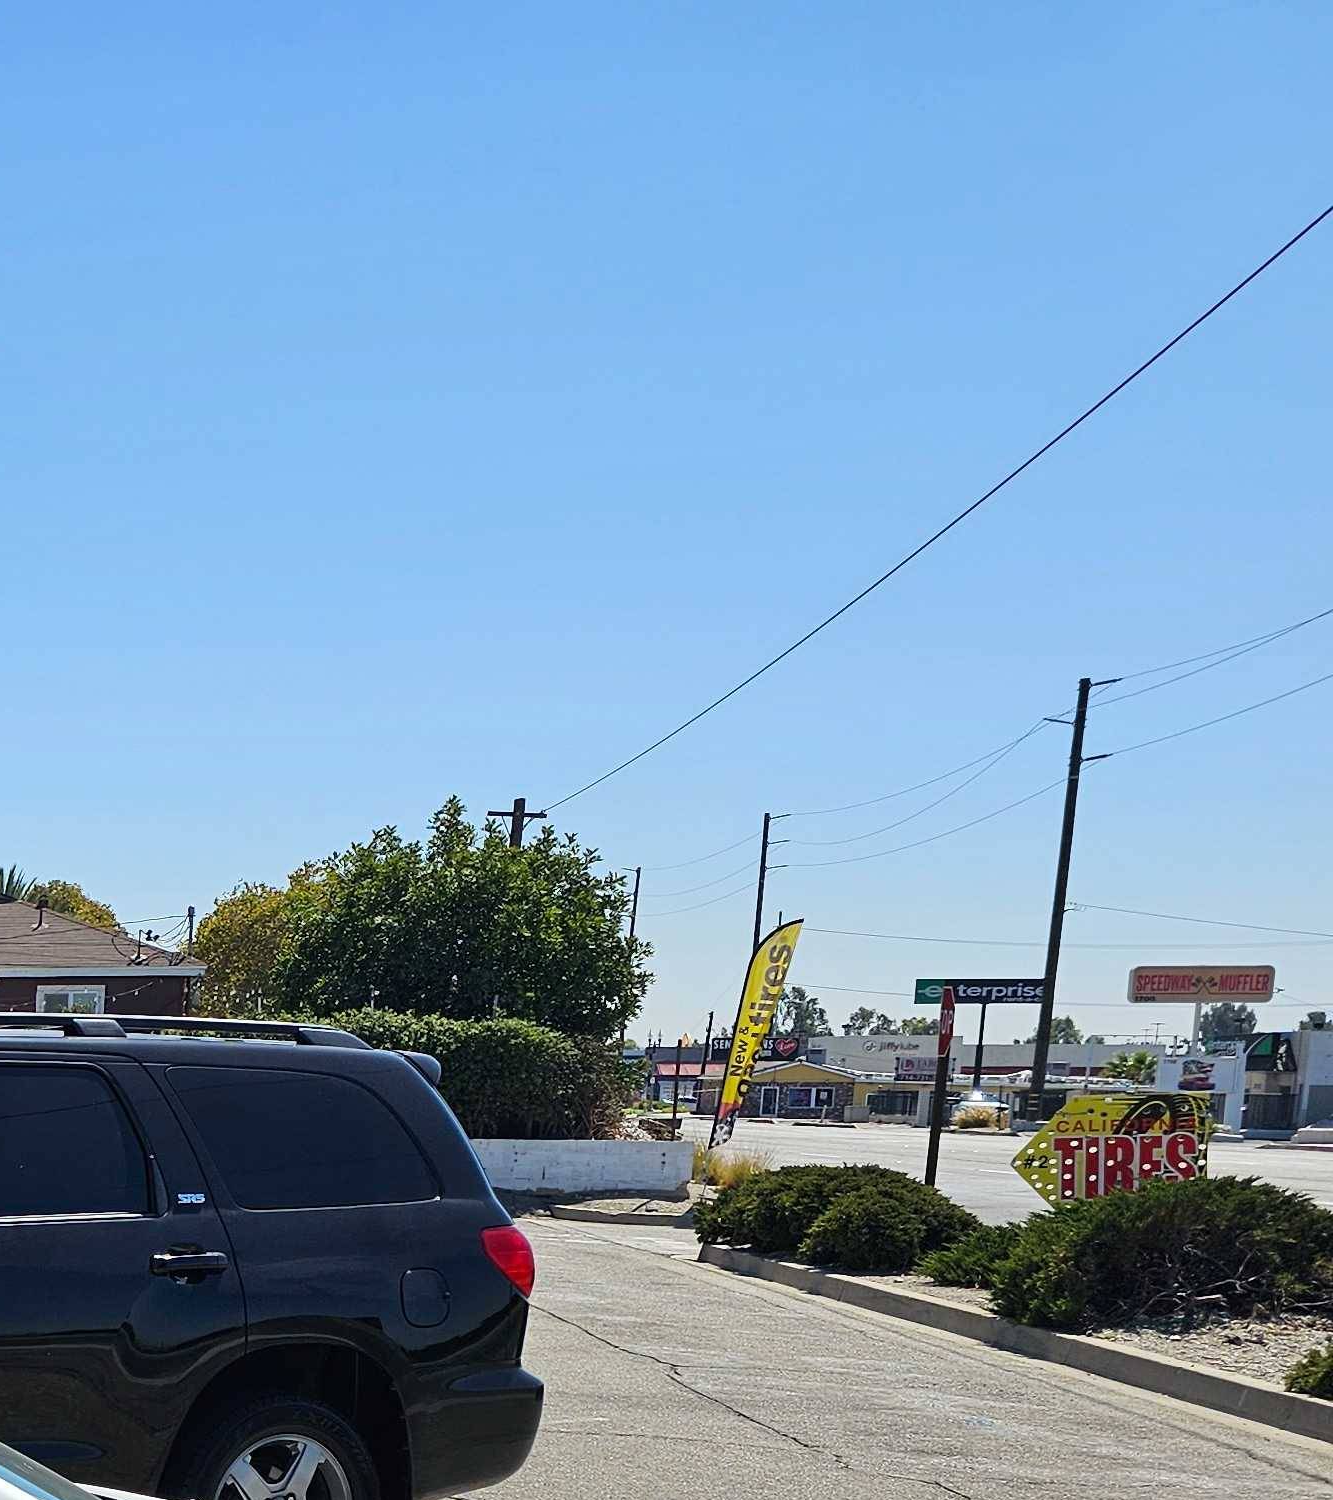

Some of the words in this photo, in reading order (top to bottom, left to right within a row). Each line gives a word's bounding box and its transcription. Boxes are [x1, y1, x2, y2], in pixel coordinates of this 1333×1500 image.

[749, 943, 793, 1026] tires
[918, 982, 1044, 1000] eterprise
[1136, 974, 1193, 992] SPEEDWAY
[1218, 974, 1270, 992] MUFFLER
[729, 1039, 749, 1077] New
[739, 1026, 749, 1035] &
[1052, 1133, 1199, 1200] TIRES
